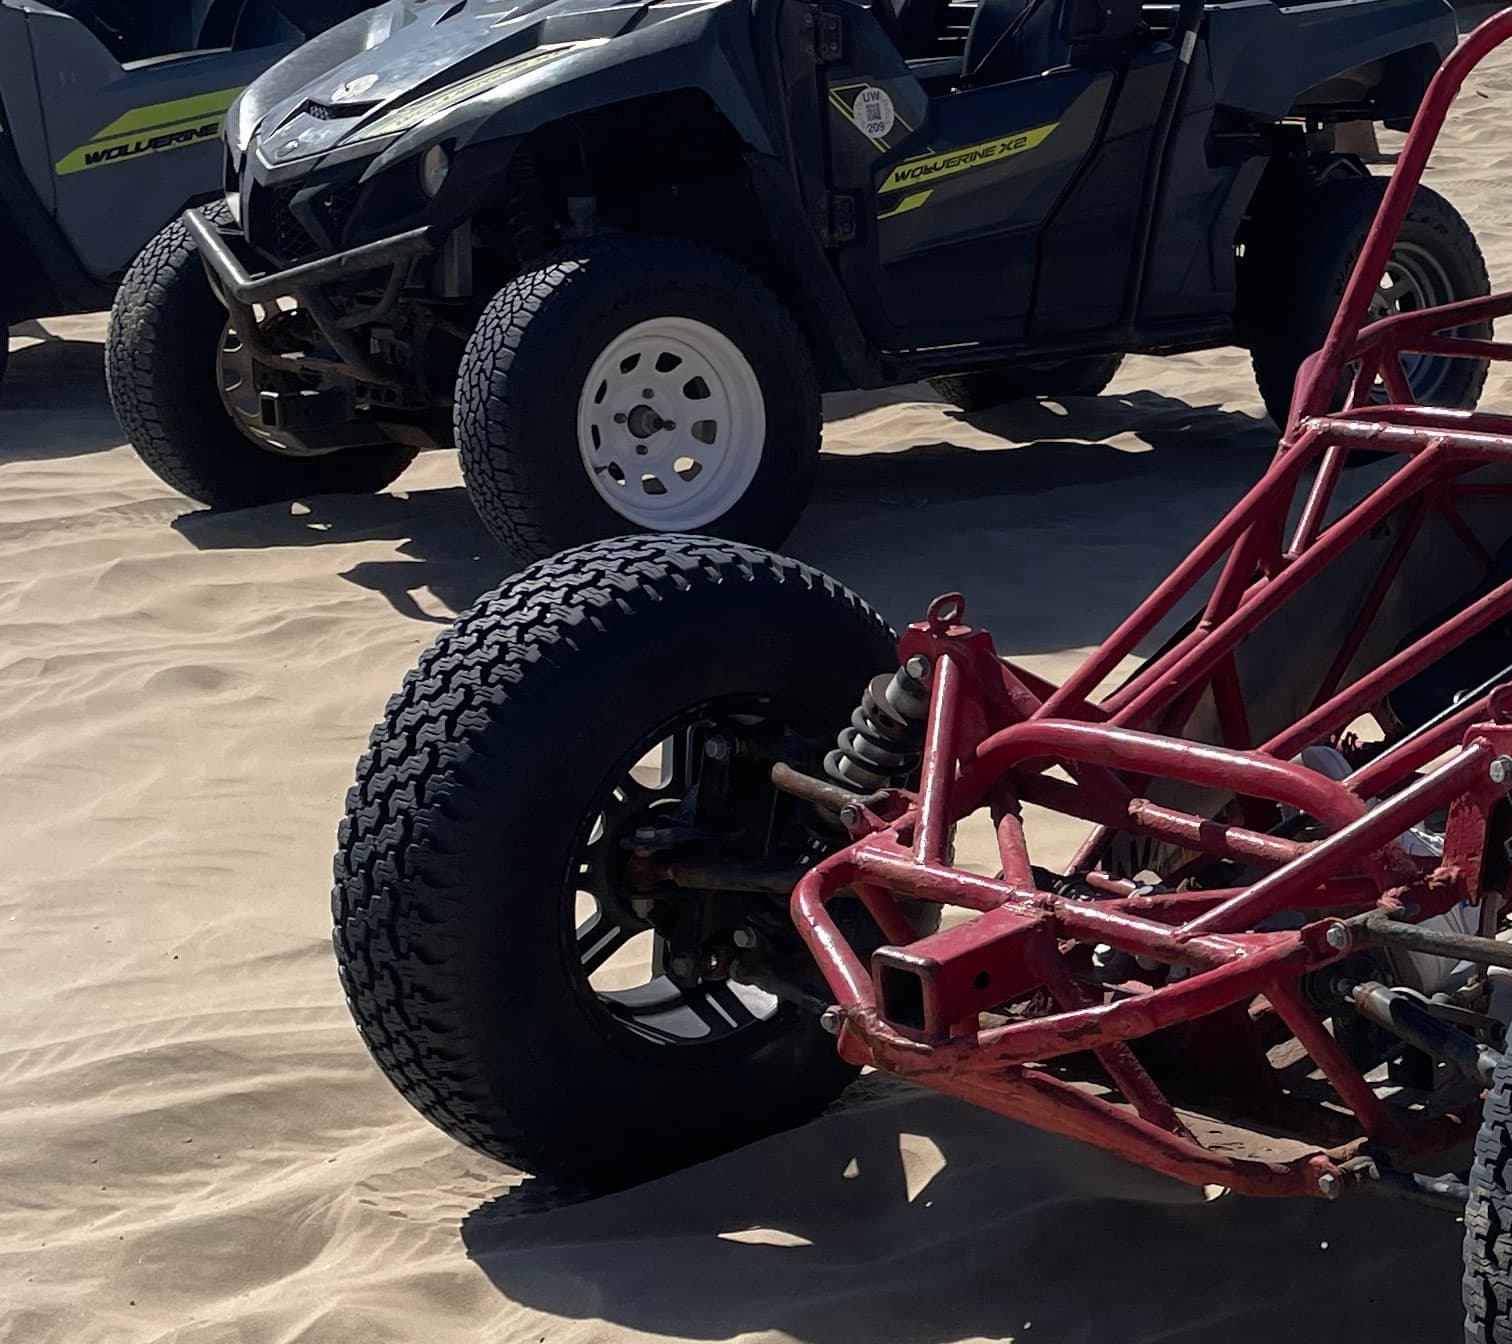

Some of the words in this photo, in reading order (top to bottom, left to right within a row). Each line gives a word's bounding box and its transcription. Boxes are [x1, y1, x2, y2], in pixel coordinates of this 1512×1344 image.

[862, 90, 881, 103] UW
[867, 121, 885, 134] 209
[85, 122, 220, 165] WOLVERINE
[894, 145, 997, 183] WOLVERINE
[999, 136, 1028, 156] X2
